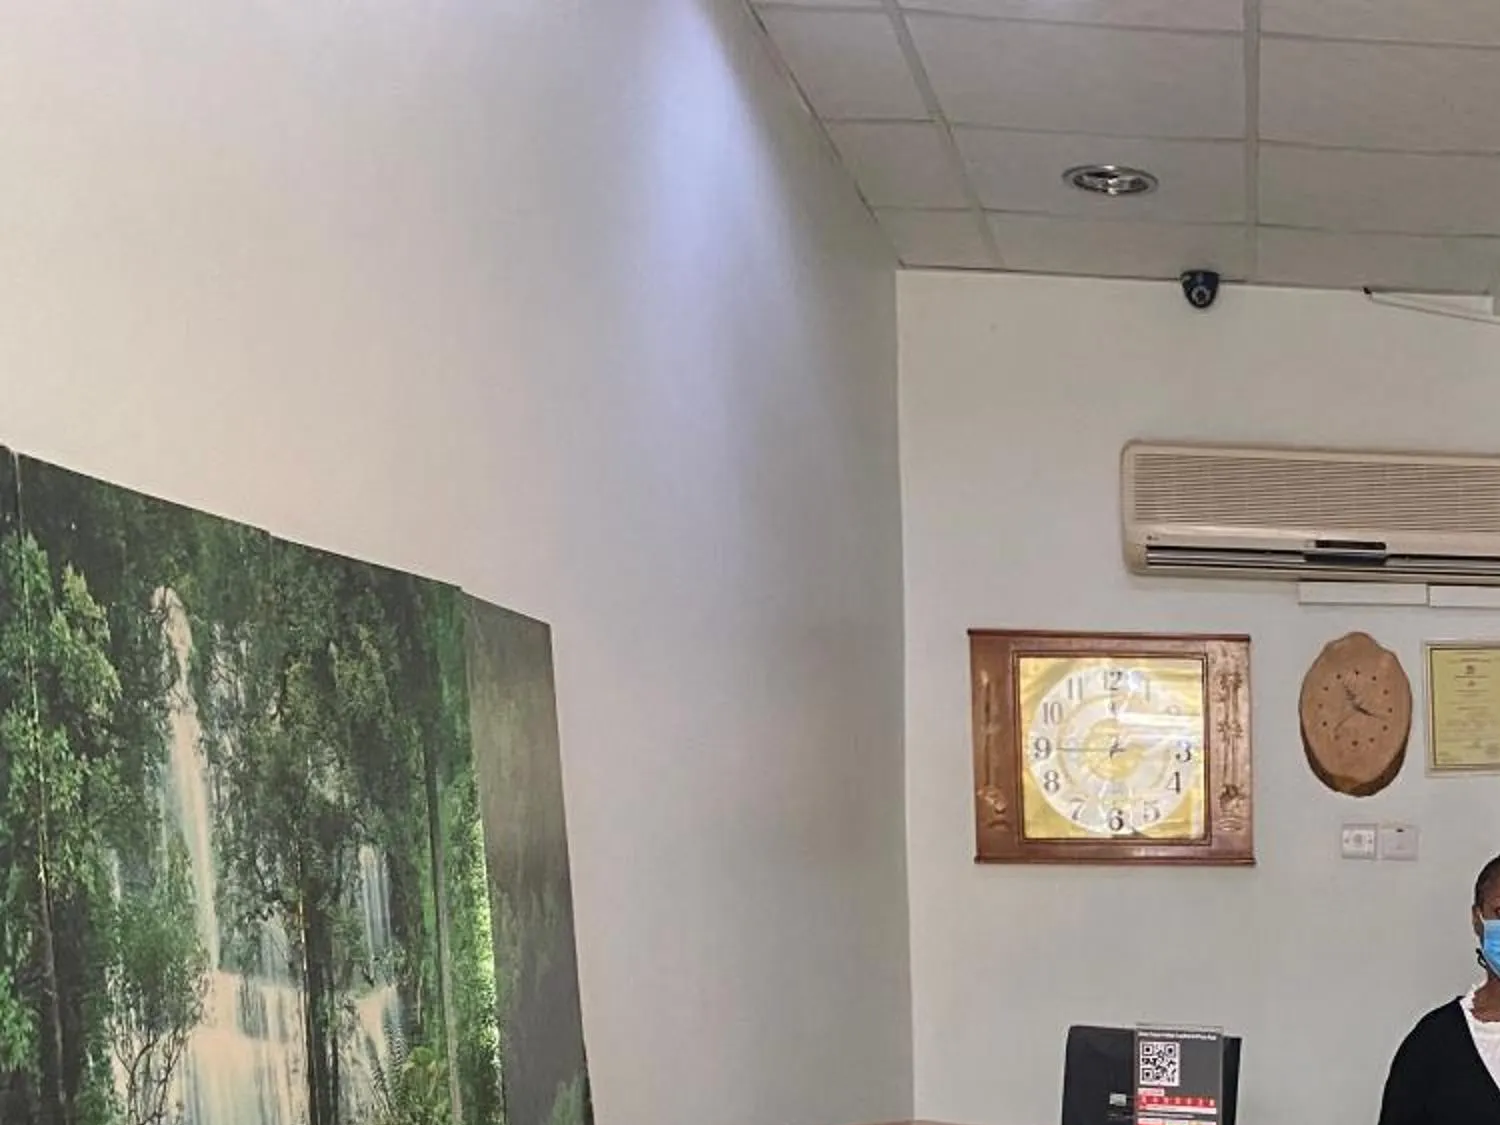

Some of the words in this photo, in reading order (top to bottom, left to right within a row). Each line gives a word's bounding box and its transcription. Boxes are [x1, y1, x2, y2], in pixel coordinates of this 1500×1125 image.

[1068, 677, 1083, 700] 11
[1103, 671, 1123, 690] 12
[1043, 702, 1063, 724] 10
[1034, 737, 1051, 760] 9
[1175, 739, 1192, 762] 3
[1044, 770, 1060, 793] 8
[1167, 771, 1181, 795] 4
[1070, 798, 1086, 820] 7
[1106, 808, 1124, 831] 6
[1143, 800, 1160, 820] 5
